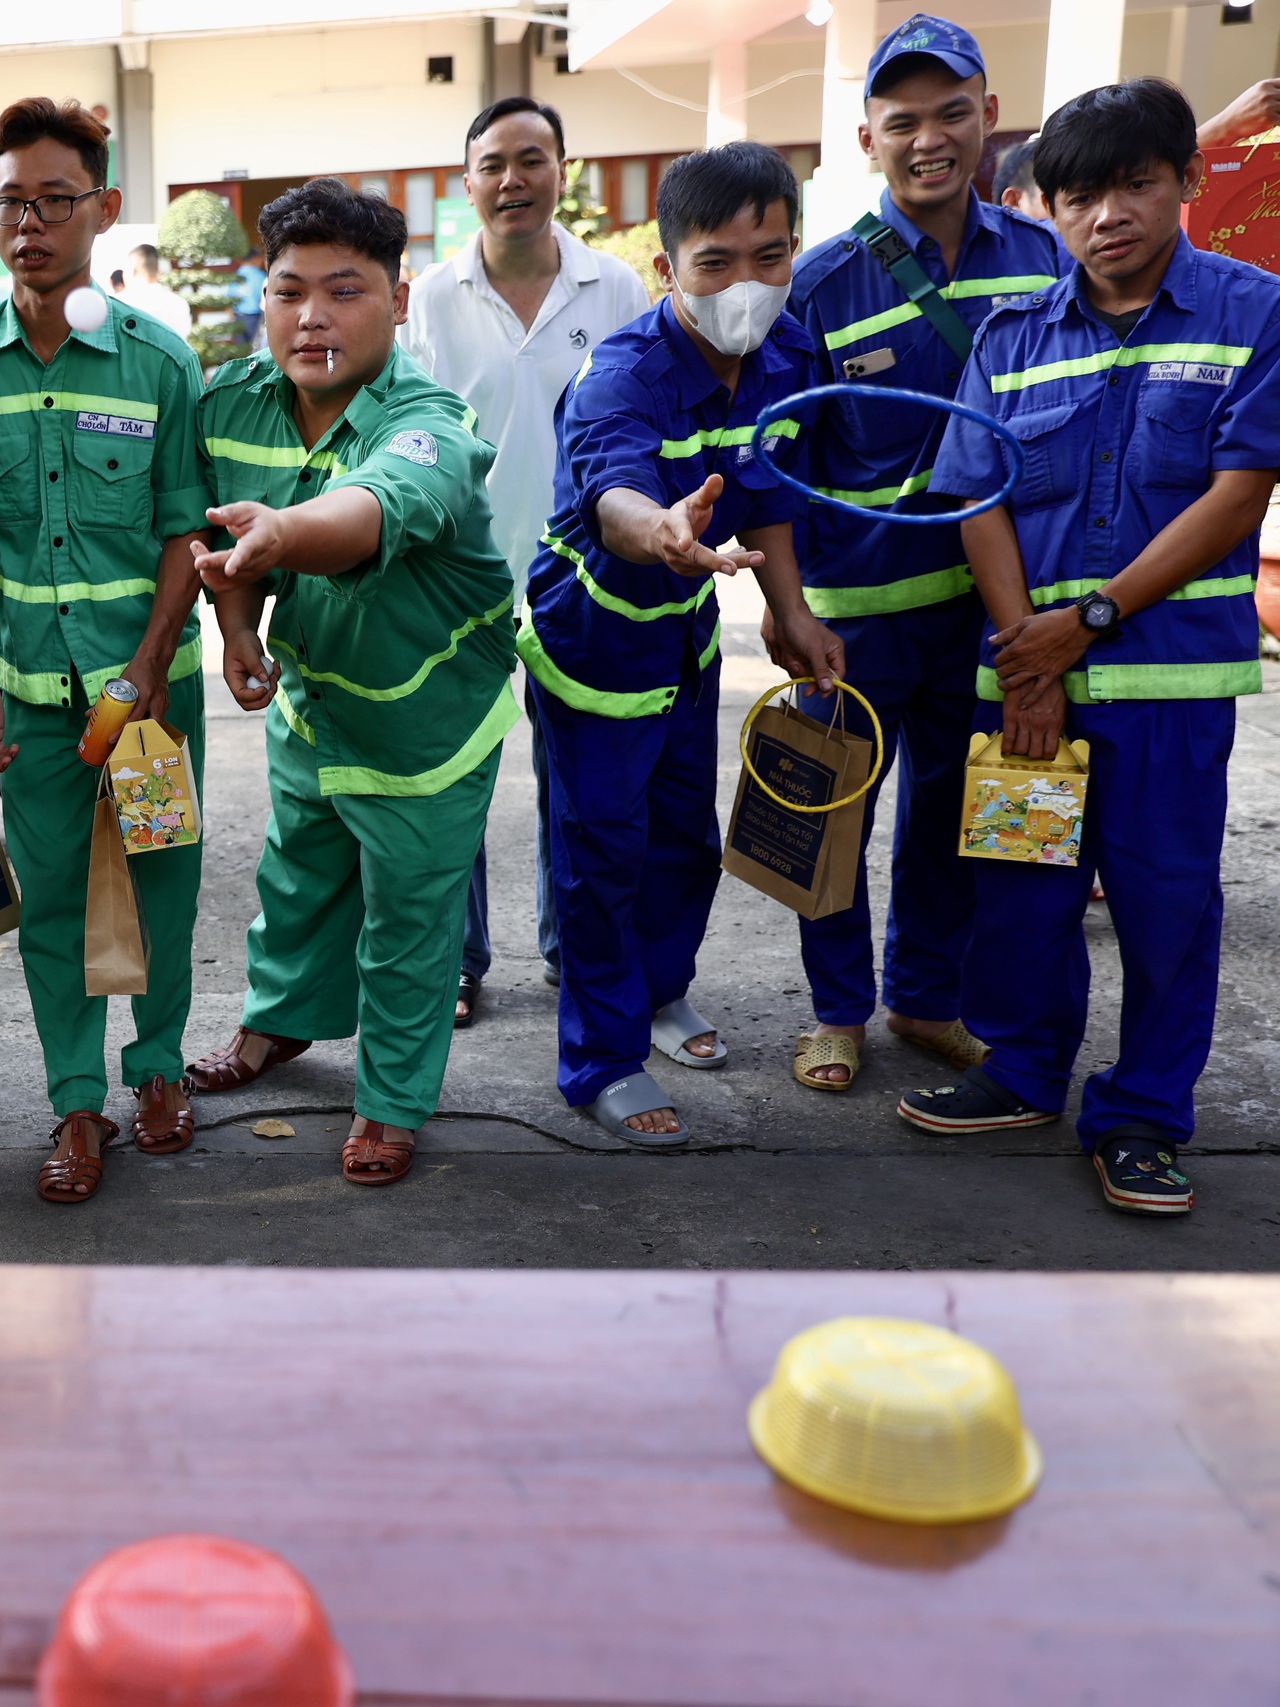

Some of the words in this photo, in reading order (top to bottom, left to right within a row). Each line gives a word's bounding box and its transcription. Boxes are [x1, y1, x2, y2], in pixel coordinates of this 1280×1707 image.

[1197, 367, 1226, 382] NAM
[77, 420, 93, 429] CHỢ
[92, 421, 107, 431] LỚN
[119, 420, 144, 434] TÂM
[152, 758, 163, 769] 6
[164, 756, 178, 764] LON
[768, 769, 783, 784] NHÀ
[784, 779, 813, 799] THUỐC
[750, 843, 770, 861] 1800
[770, 855, 792, 874] 6928
